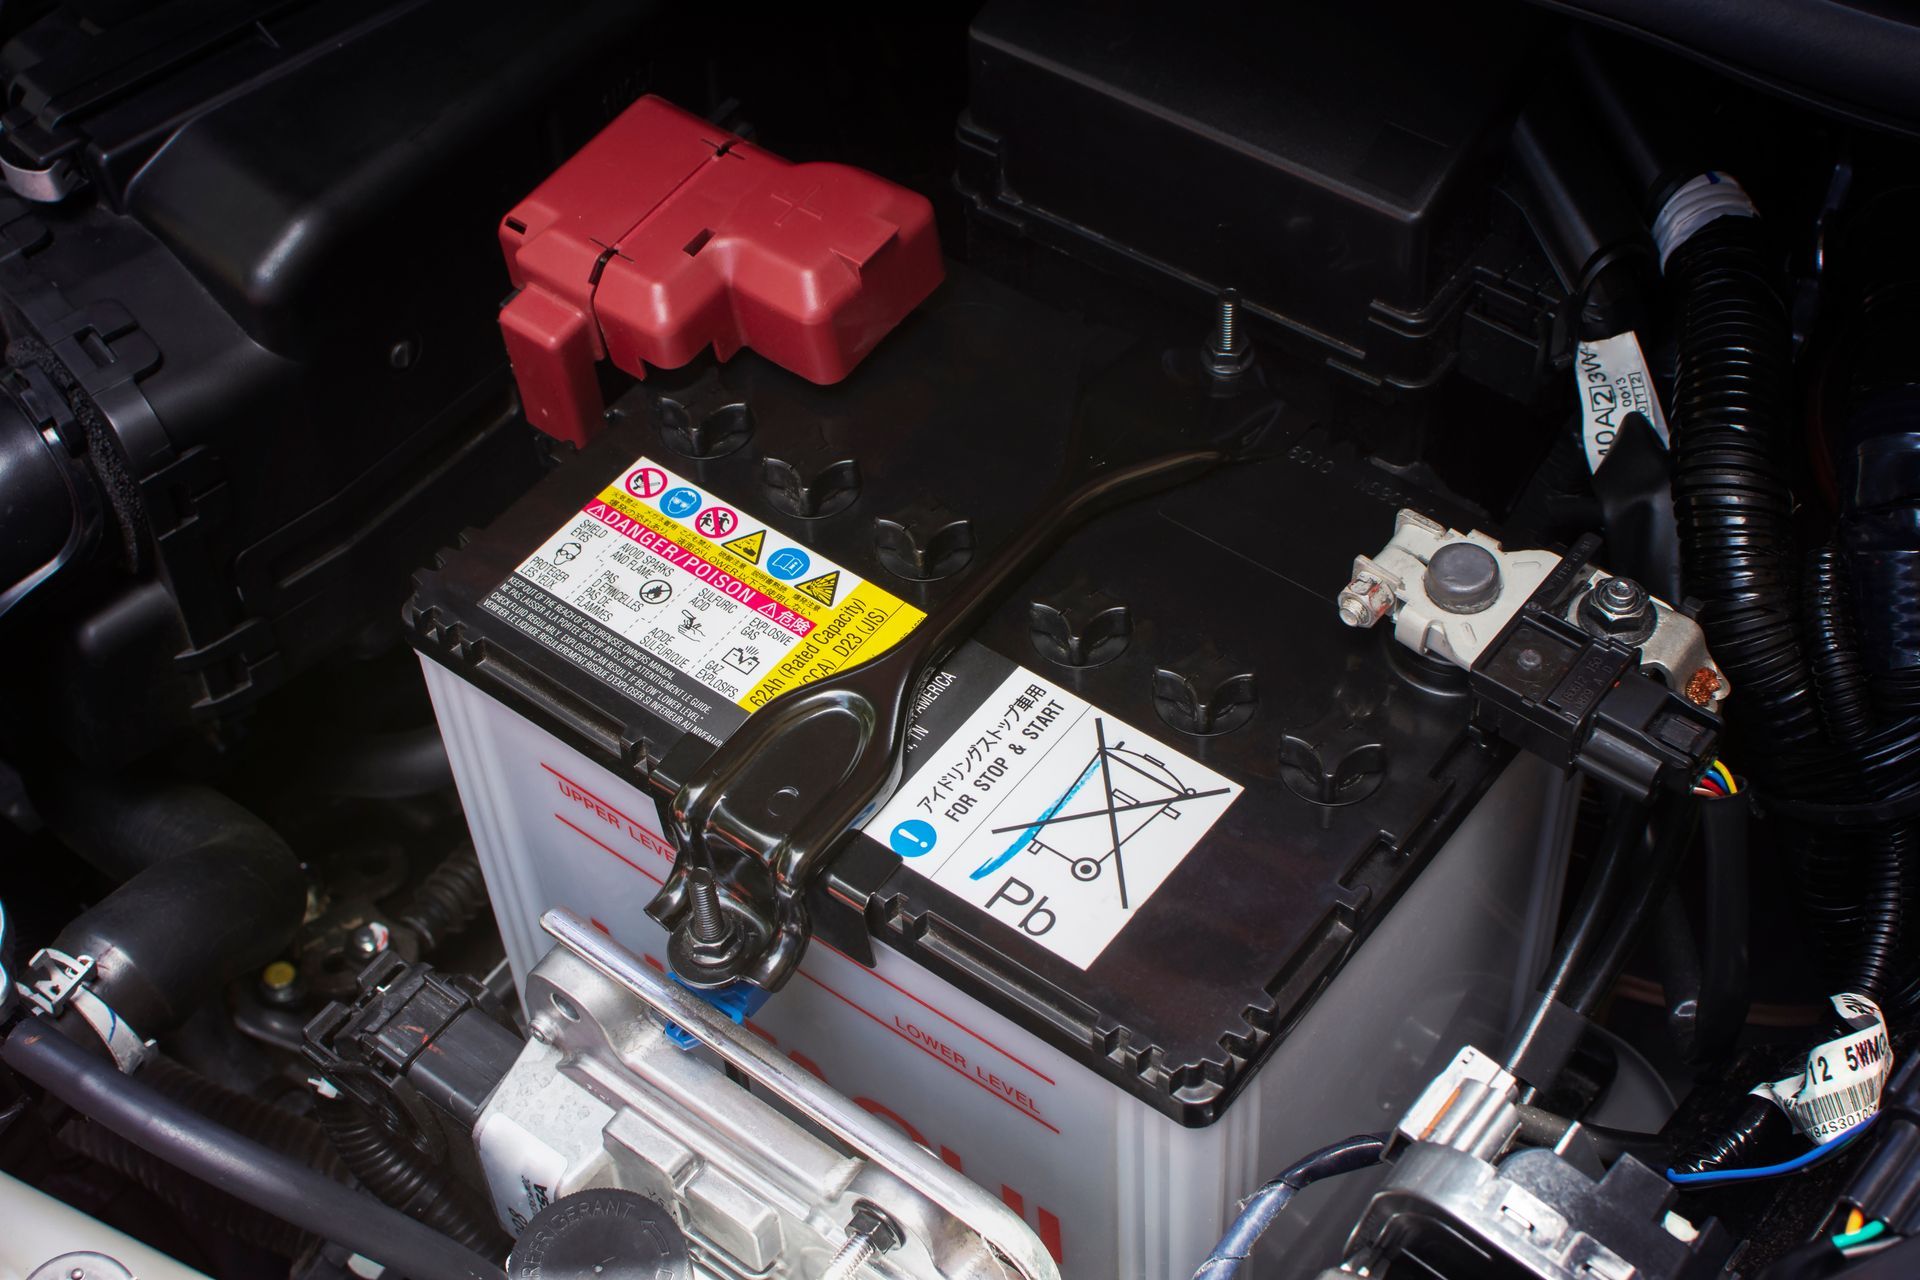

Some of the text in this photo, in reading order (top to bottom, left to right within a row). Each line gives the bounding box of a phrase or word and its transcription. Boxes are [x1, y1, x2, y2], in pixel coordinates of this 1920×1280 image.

[1616, 377, 1632, 407] 0013
[570, 526, 592, 542] EYES
[579, 519, 607, 538] SHIELD
[520, 564, 538, 577] LES
[529, 556, 569, 582] PROTEGER
[604, 511, 814, 635] DANGER/POISON 危険
[610, 550, 654, 579] AND FLAME
[618, 542, 674, 576] AVOID SPARKS
[600, 569, 619, 583] PAS
[573, 595, 613, 621] FLAMMES
[582, 586, 612, 607] PAS DE
[688, 596, 710, 611] ACID
[698, 587, 737, 613] SULFURIC
[489, 591, 512, 607] CHECK
[508, 602, 528, 616] FLUID
[559, 633, 596, 658] EXPLOSION
[591, 652, 609, 666] CAN
[605, 660, 631, 678] RESULT
[628, 674, 638, 682] IF
[498, 582, 512, 593] NE
[506, 587, 524, 600] PAS
[518, 594, 547, 614] LAISSER
[543, 609, 551, 617] A
[548, 612, 559, 621] LA
[555, 616, 582, 635] PORTEE
[577, 630, 595, 642] DES
[634, 665, 683, 696] ATTENTIVEMENT
[681, 692, 692, 702] LE
[505, 575, 526, 589] KEEP
[520, 584, 538, 597] OUT
[532, 591, 546, 602] OF
[542, 596, 557, 608] THE
[552, 603, 577, 620] REACH
[573, 615, 585, 624] OF
[621, 644, 651, 665] OWNERS
[646, 660, 677, 680] MANUAL
[648, 627, 674, 645] ACIDE
[740, 625, 759, 640] GAS
[749, 617, 793, 645] EXPLOSIVE
[832, 632, 862, 657] D23
[855, 607, 888, 634] (JIS)
[481, 598, 510, 618] VERIFIER
[506, 613, 518, 622] LE
[513, 617, 541, 637] LIQUIDE
[641, 695, 653, 705] SI
[649, 700, 685, 723] INFERIEUR
[680, 718, 694, 729] AU
[639, 635, 689, 668] SULFURIQUE
[704, 659, 724, 675] GAZ
[749, 598, 865, 708] 62Ah (Rated Capacity)
[916, 683, 1048, 814] アイドリングストップ車用
[943, 698, 1067, 823] FOR STOP & START
[558, 780, 676, 864] UPPER LEVE
[984, 876, 1057, 937] Pb
[894, 1015, 1040, 1114] LOWER LEVEL
[521, 1199, 636, 1279] REFRIGERANT
